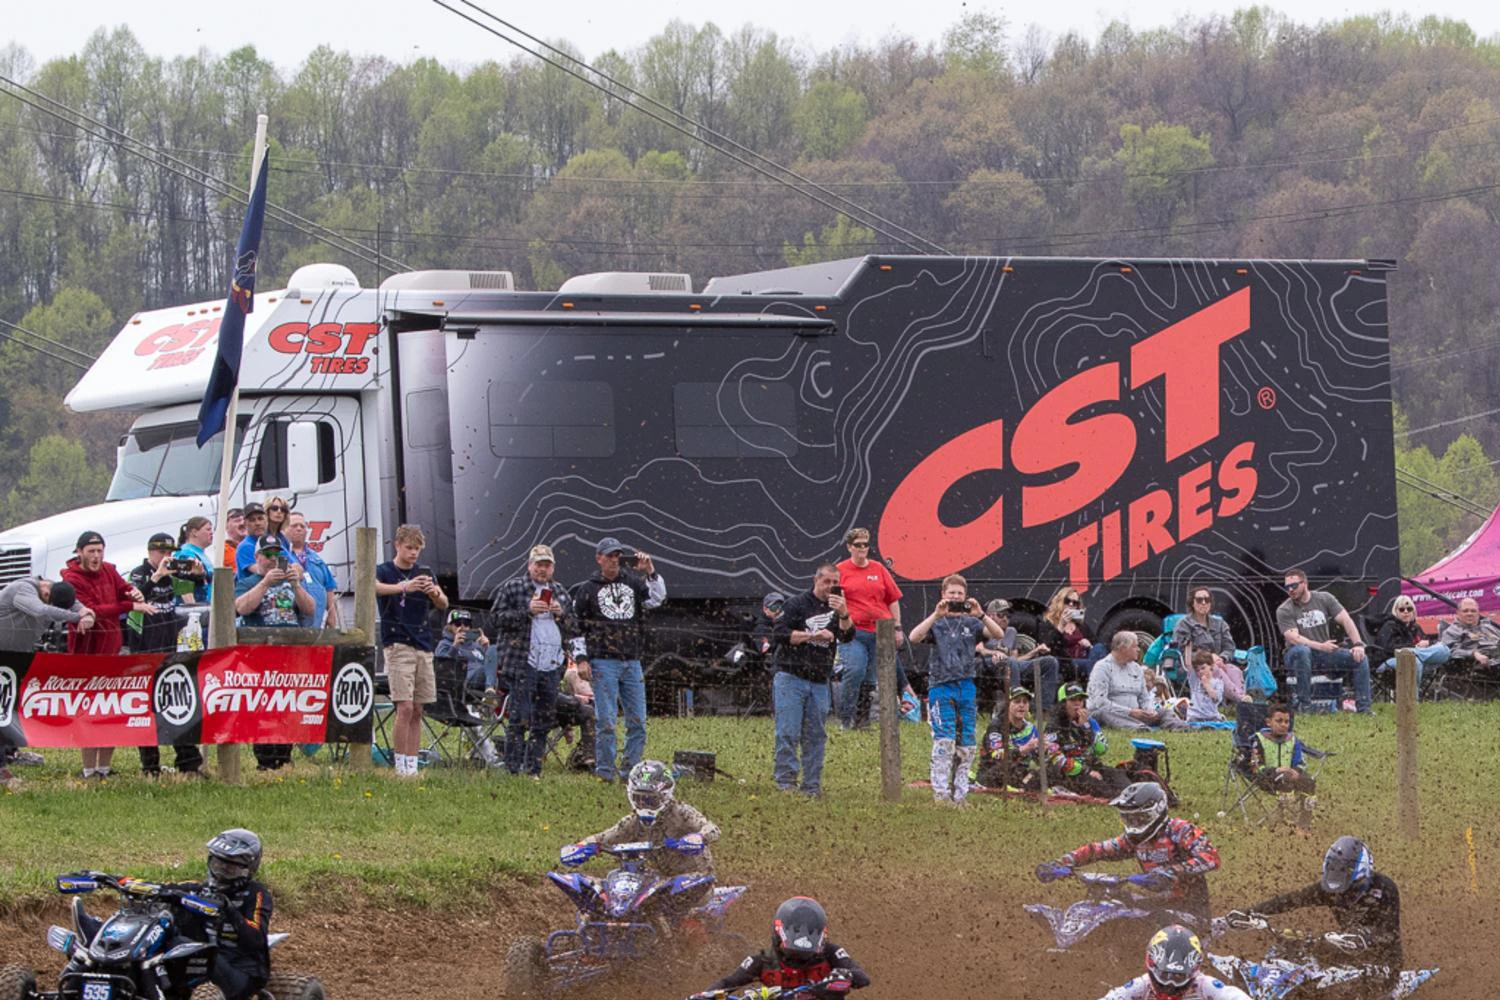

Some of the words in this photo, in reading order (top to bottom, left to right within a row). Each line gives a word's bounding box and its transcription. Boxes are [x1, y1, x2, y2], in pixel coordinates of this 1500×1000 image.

[268, 321, 380, 354] CST
[147, 347, 206, 371] TIRES
[310, 357, 370, 375] TIRES
[878, 286, 1251, 581] CST
[1058, 441, 1259, 594] TIRES
[42, 676, 88, 691] ROCKY
[83, 675, 152, 691] MOUNTAIN
[223, 670, 261, 688] ROCKY
[261, 670, 329, 688] MOUNTAIN
[338, 680, 365, 706] RM
[126, 717, 151, 728] .com
